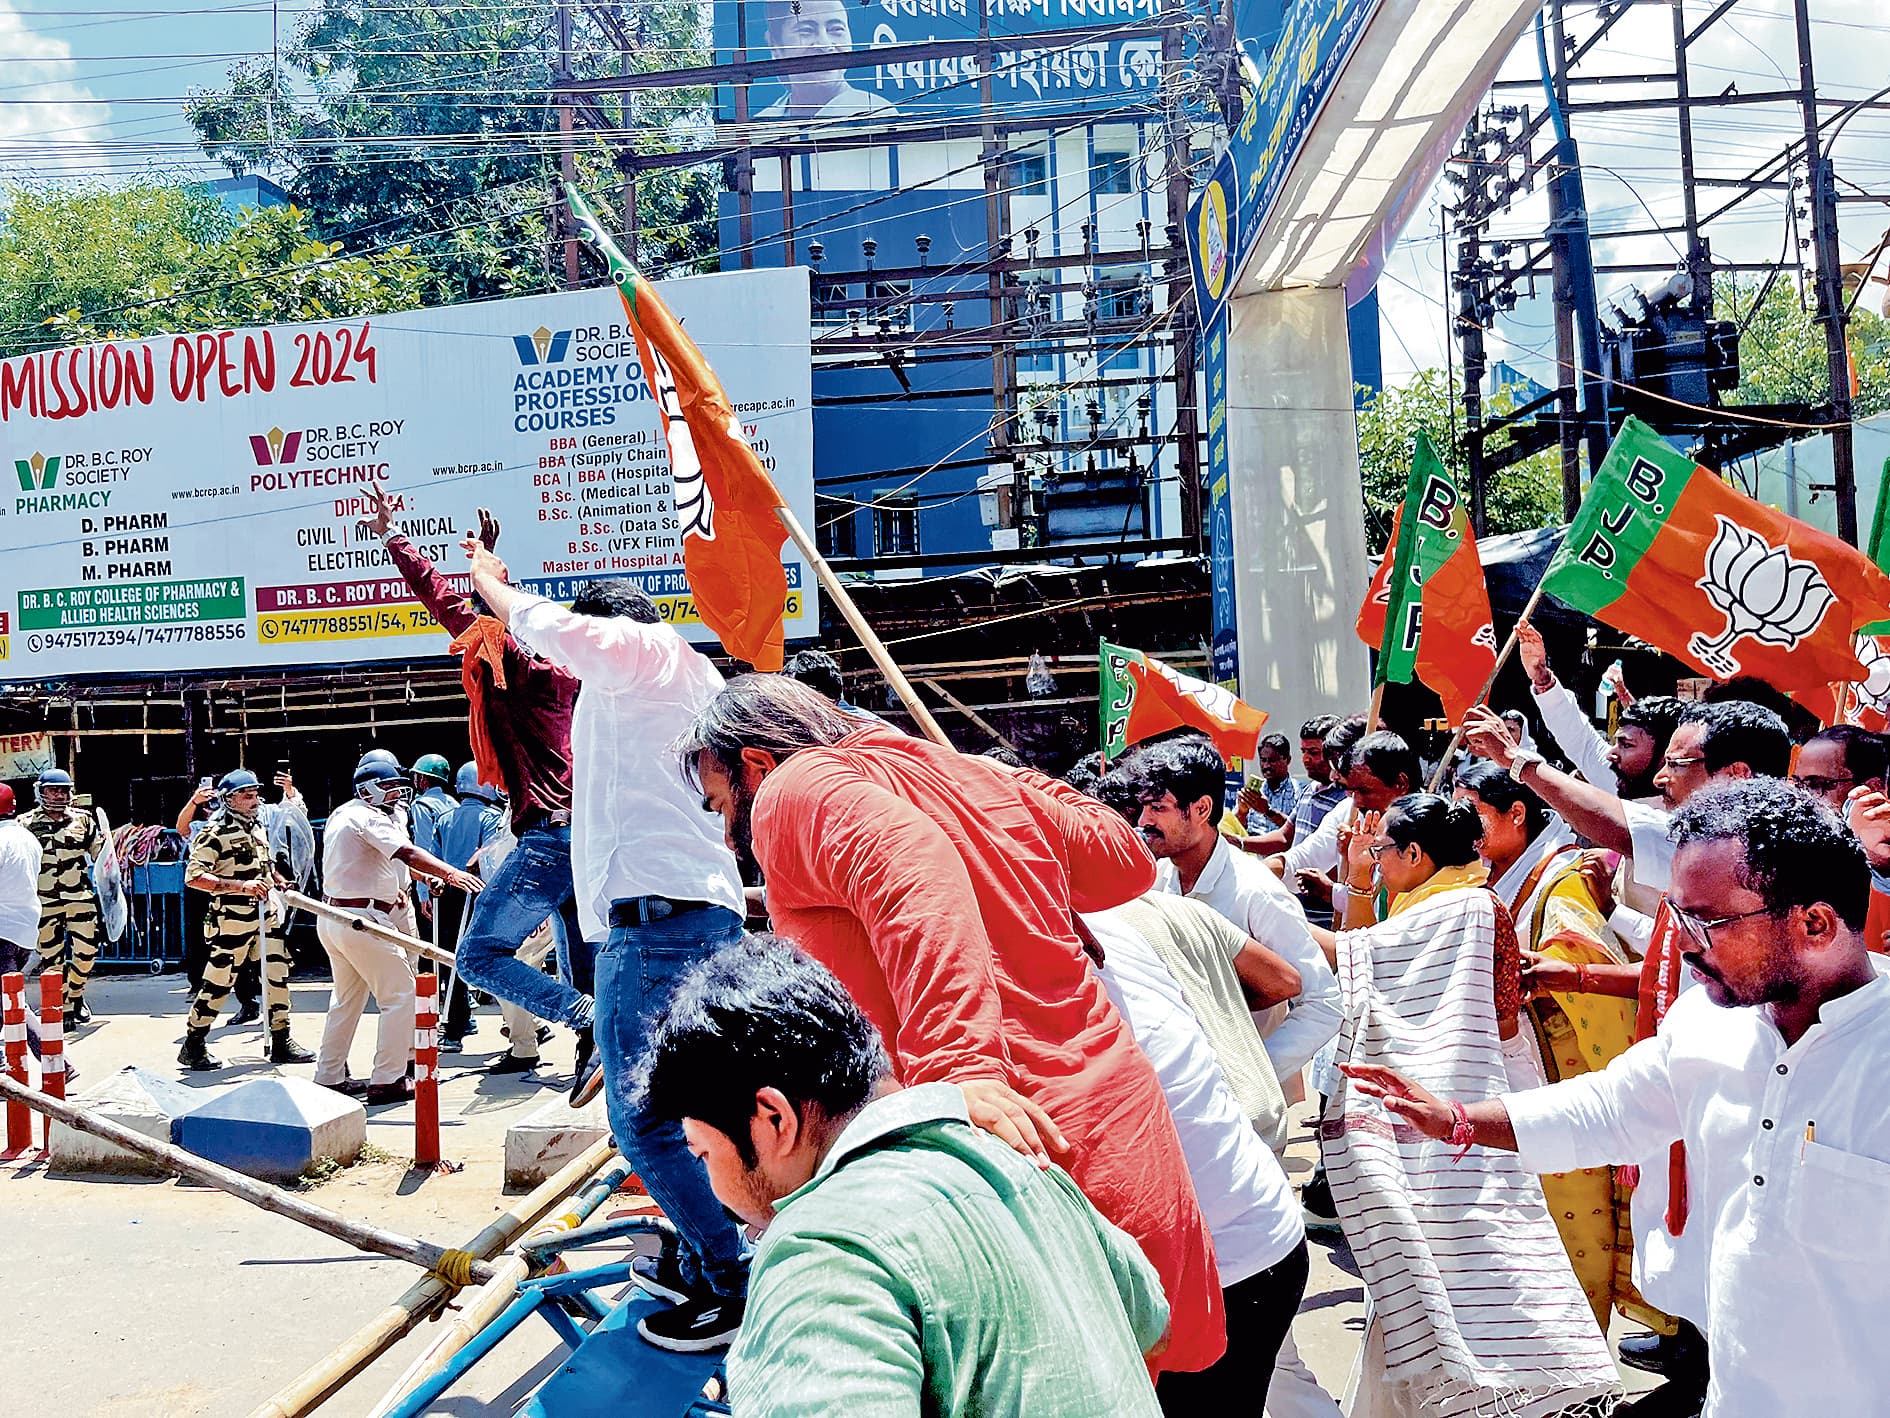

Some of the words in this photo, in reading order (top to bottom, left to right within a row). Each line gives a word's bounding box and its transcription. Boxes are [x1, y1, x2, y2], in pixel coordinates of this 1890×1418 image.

[575, 327, 605, 344] DR.
[170, 329, 277, 402] OPEN
[290, 321, 378, 389] 2024
[575, 341, 640, 362] SOCIET
[513, 364, 619, 392] ACADEMY
[513, 381, 655, 412] PROFESSION
[513, 406, 616, 433] COURSES
[306, 427, 333, 443] DR.
[336, 424, 367, 441] B.C.
[369, 419, 405, 438] ROY
[549, 436, 578, 451] BBA
[582, 430, 647, 450] (General)
[65, 453, 90, 469] DR.
[91, 450, 119, 466] B.C.
[120, 447, 154, 464] ROY
[306, 441, 380, 462] SOCIETY
[538, 455, 567, 469] BBA
[571, 451, 623, 469] (Supply
[627, 447, 667, 462] Chain
[65, 466, 132, 486] SOCIETY
[249, 463, 391, 492] POLYTECHNIC
[432, 459, 504, 476] www.bcrp.ac.in
[533, 473, 561, 487] BCA
[578, 469, 607, 483] BBA
[15, 490, 112, 516] PHARMACY
[171, 484, 241, 500] www.bcrcp.ac.in
[541, 490, 576, 504] B.Sc.
[580, 483, 641, 503] (Medical
[645, 482, 671, 496] Lab
[538, 507, 573, 521] B.Sc.
[577, 502, 652, 520] (Animation
[656, 500, 668, 513] &
[81, 517, 99, 534] D.
[103, 512, 169, 532] PHARM
[580, 522, 615, 536] B.Sc.
[620, 519, 657, 536] (Data
[82, 541, 100, 558] B.
[104, 537, 170, 556] PHARM
[297, 526, 337, 547] CIVIL
[568, 540, 603, 554] B.Sc.
[607, 536, 641, 554] (VFX
[645, 534, 675, 549] Flim
[82, 565, 102, 581] M.
[107, 561, 172, 579] PHARM
[308, 549, 397, 572] ELECTRICA
[543, 559, 590, 574] Master
[594, 557, 607, 570] of
[611, 552, 668, 570] Hospital
[23, 593, 41, 609] DR.
[43, 592, 55, 608] B.
[56, 591, 68, 607] C.
[70, 589, 92, 607] ROY
[94, 587, 143, 605] COLLEGE
[144, 585, 160, 602] OF
[163, 581, 228, 601] PHARMACY
[230, 580, 240, 597] &
[277, 588, 303, 606] DR.
[306, 587, 322, 604] B.
[325, 586, 342, 603] C.
[346, 583, 377, 602] ROY
[545, 582, 556, 599] B.
[558, 581, 570, 598] C.
[648, 574, 663, 593] OF
[60, 608, 97, 625] ALLIED
[99, 605, 142, 622] HEALTH
[144, 602, 200, 620] SCIENCES
[45, 622, 246, 649] 9475172394/7477788556
